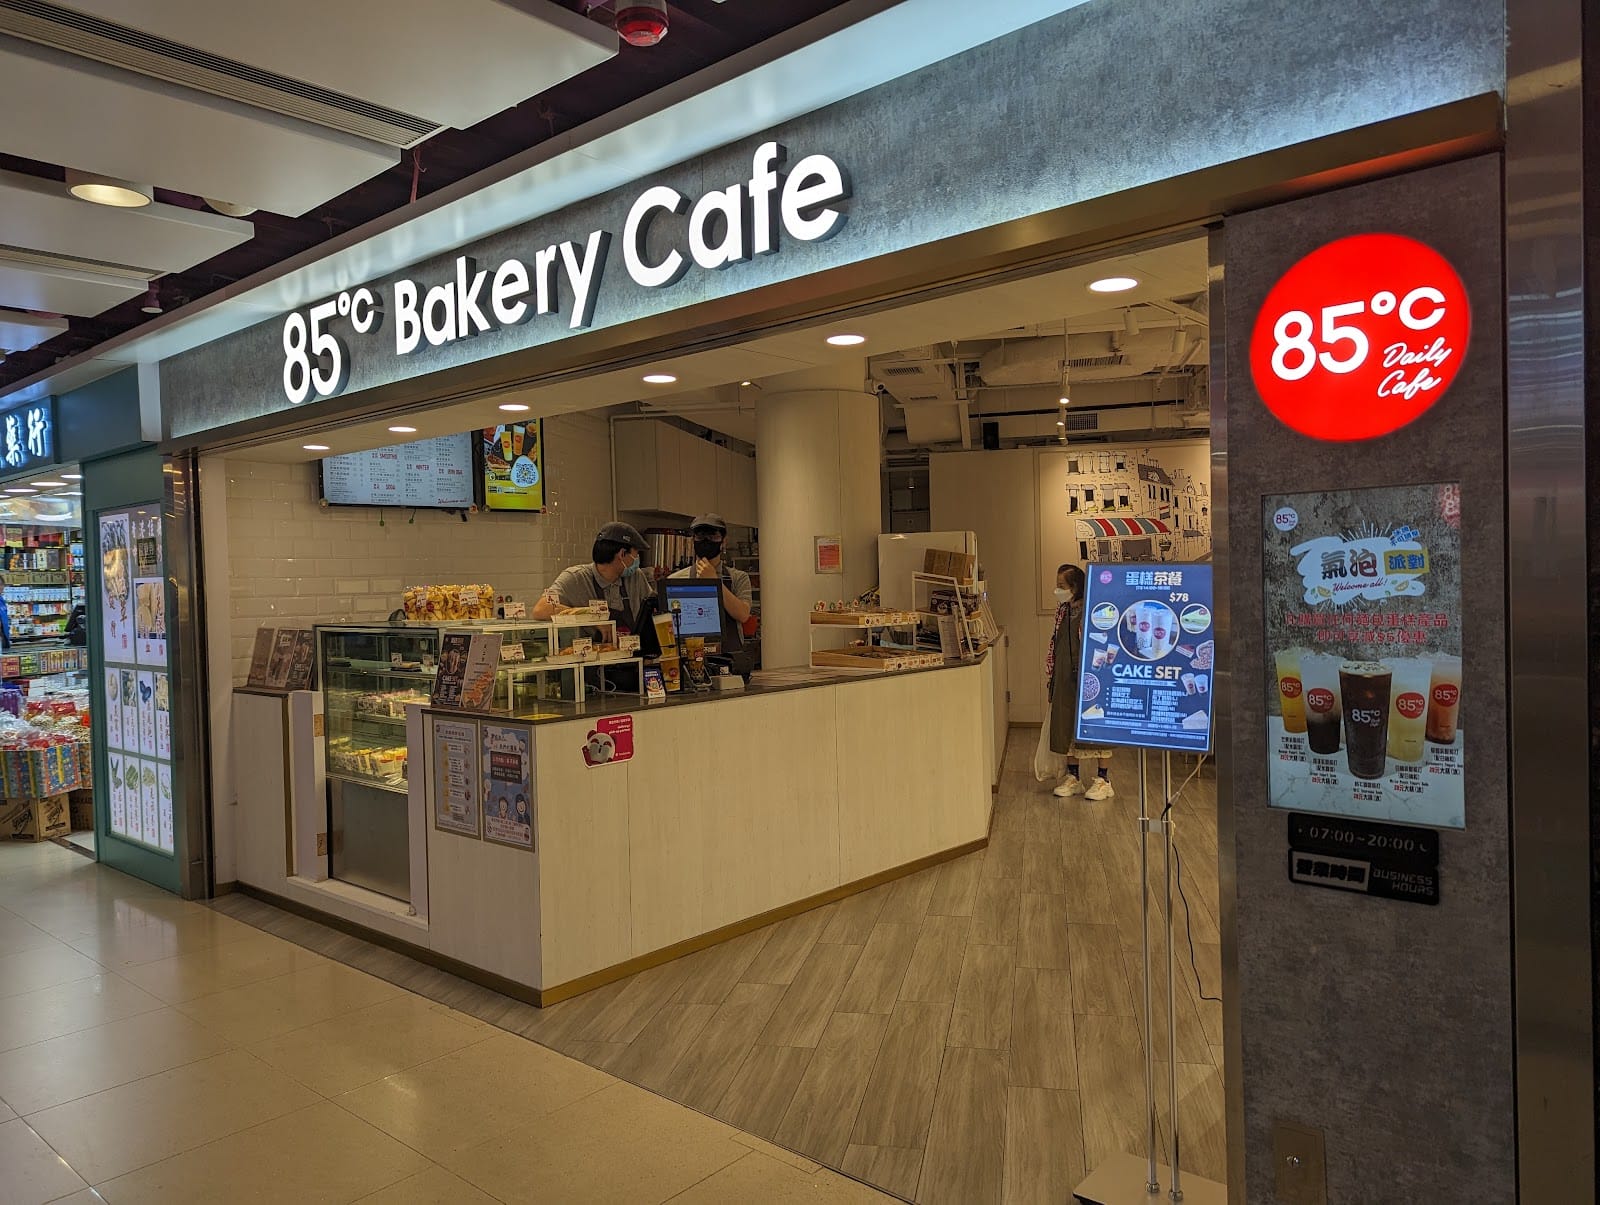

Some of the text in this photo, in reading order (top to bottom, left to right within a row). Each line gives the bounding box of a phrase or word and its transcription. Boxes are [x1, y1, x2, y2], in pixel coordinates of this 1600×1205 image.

[283, 141, 847, 403] 85°C Bakery Cafe
[1271, 286, 1446, 381] 85°C
[1383, 337, 1452, 367] Daily
[1377, 367, 1442, 400] Cafe
[1321, 549, 1425, 580] 氣泡 派對
[1125, 571, 1183, 586] 蛋糕茶餐
[1332, 580, 1368, 592] Welcome
[1169, 592, 1189, 603] $78
[1112, 664, 1182, 680] CAKE SET
[1372, 869, 1433, 886] BUSINESS
[1392, 881, 1435, 896] HOURS
